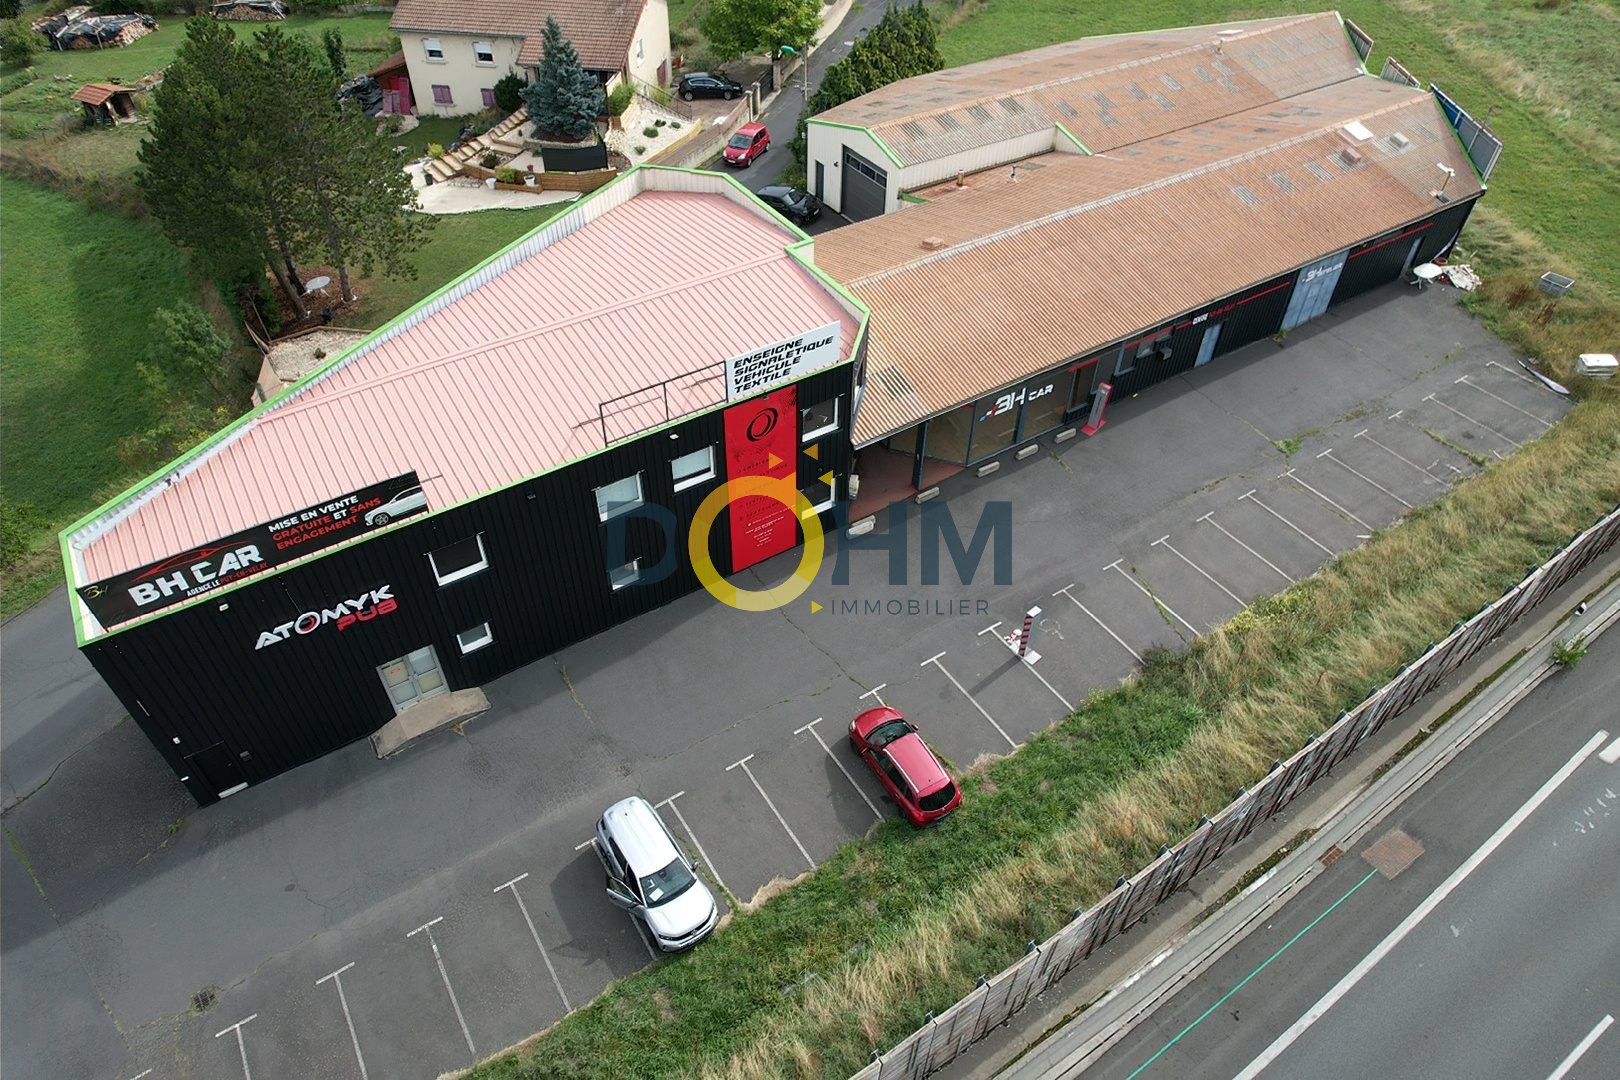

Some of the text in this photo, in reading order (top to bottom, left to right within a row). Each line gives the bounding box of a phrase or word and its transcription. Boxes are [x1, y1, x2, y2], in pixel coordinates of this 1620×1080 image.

[734, 338, 804, 369] ENSEIGNE
[734, 335, 834, 378] SIGNALETIQUE
[734, 355, 802, 385] VEHICULE
[734, 367, 792, 393] TEXTILE
[1028, 384, 1054, 401] CAR
[268, 495, 359, 533] MISE EN VENTE
[272, 497, 382, 541] GRATUITE ET SANS
[276, 515, 358, 550] ENGAGEMENT
[127, 544, 264, 606] BH CAR
[186, 562, 268, 597] AGENCE LE PUY-EN-VELAY
[255, 584, 395, 650] ATOMYK
[336, 597, 398, 632] PUB
